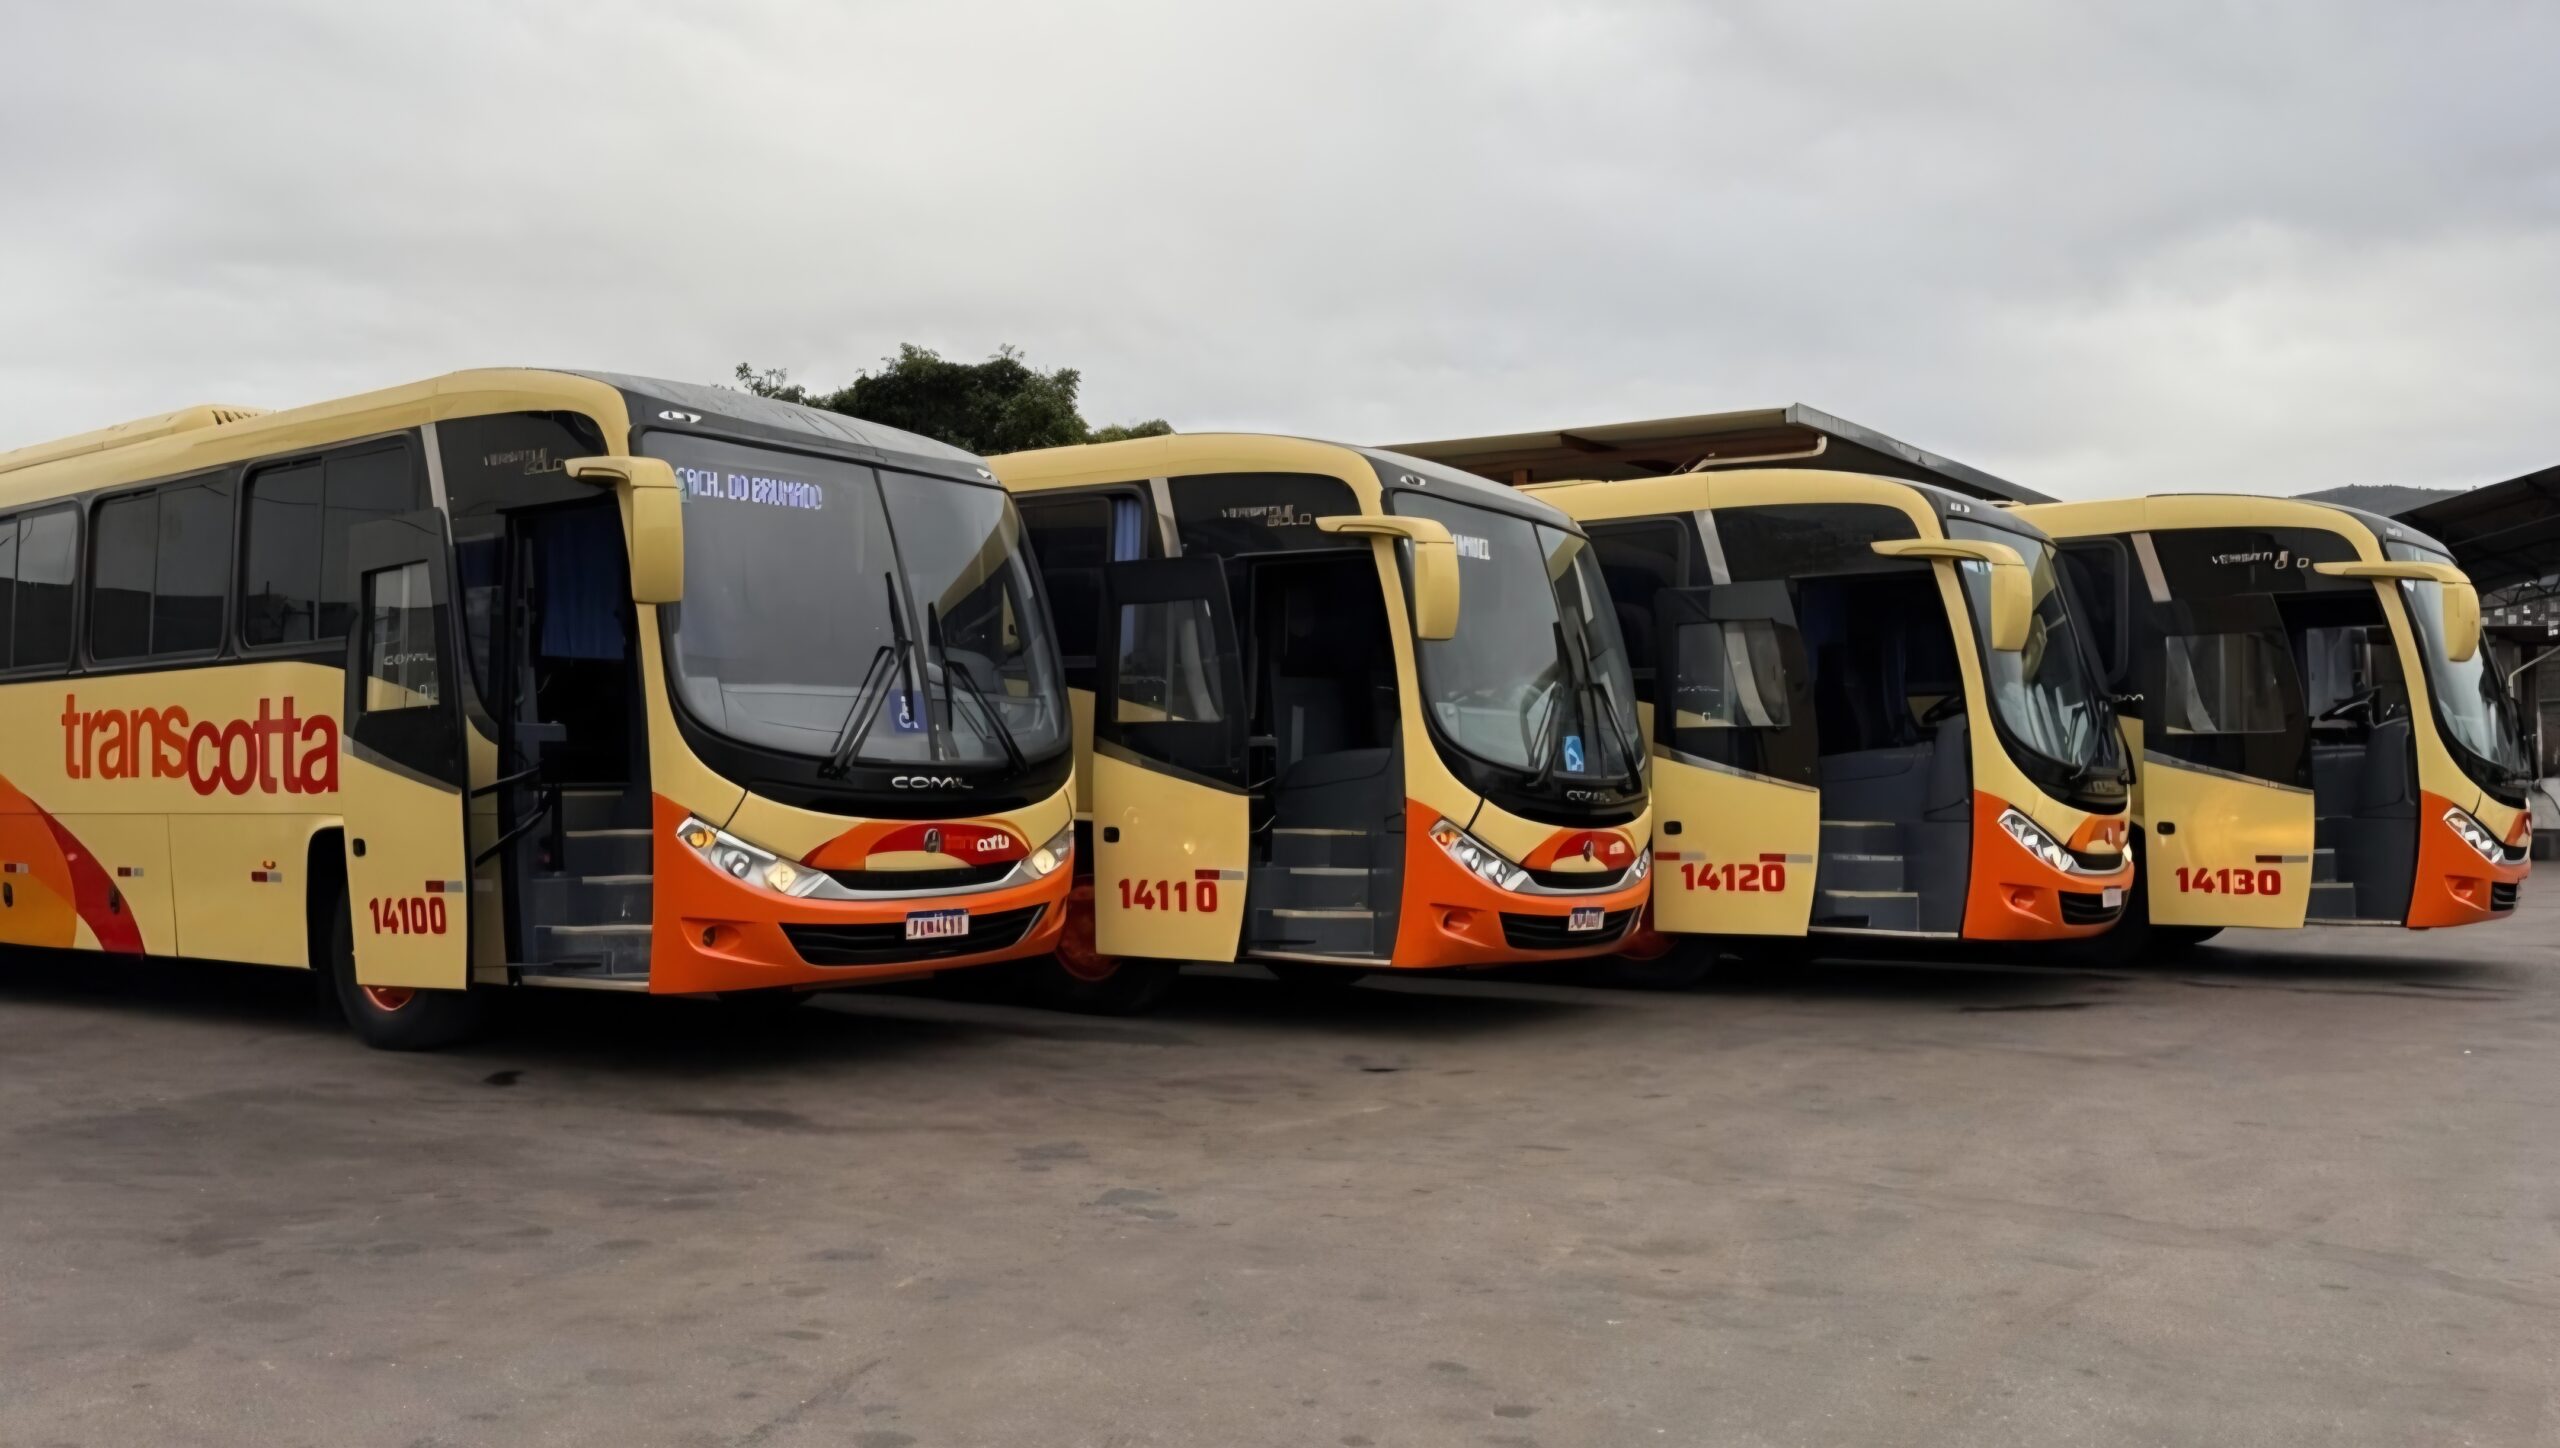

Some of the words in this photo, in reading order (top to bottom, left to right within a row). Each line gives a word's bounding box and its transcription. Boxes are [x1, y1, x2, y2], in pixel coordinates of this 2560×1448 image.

[61, 693, 339, 796] transcotta
[1680, 862, 1786, 892] 14120
[2175, 867, 2281, 896] 14130
[1118, 878, 1218, 913] 14110
[369, 897, 447, 935] 14100
